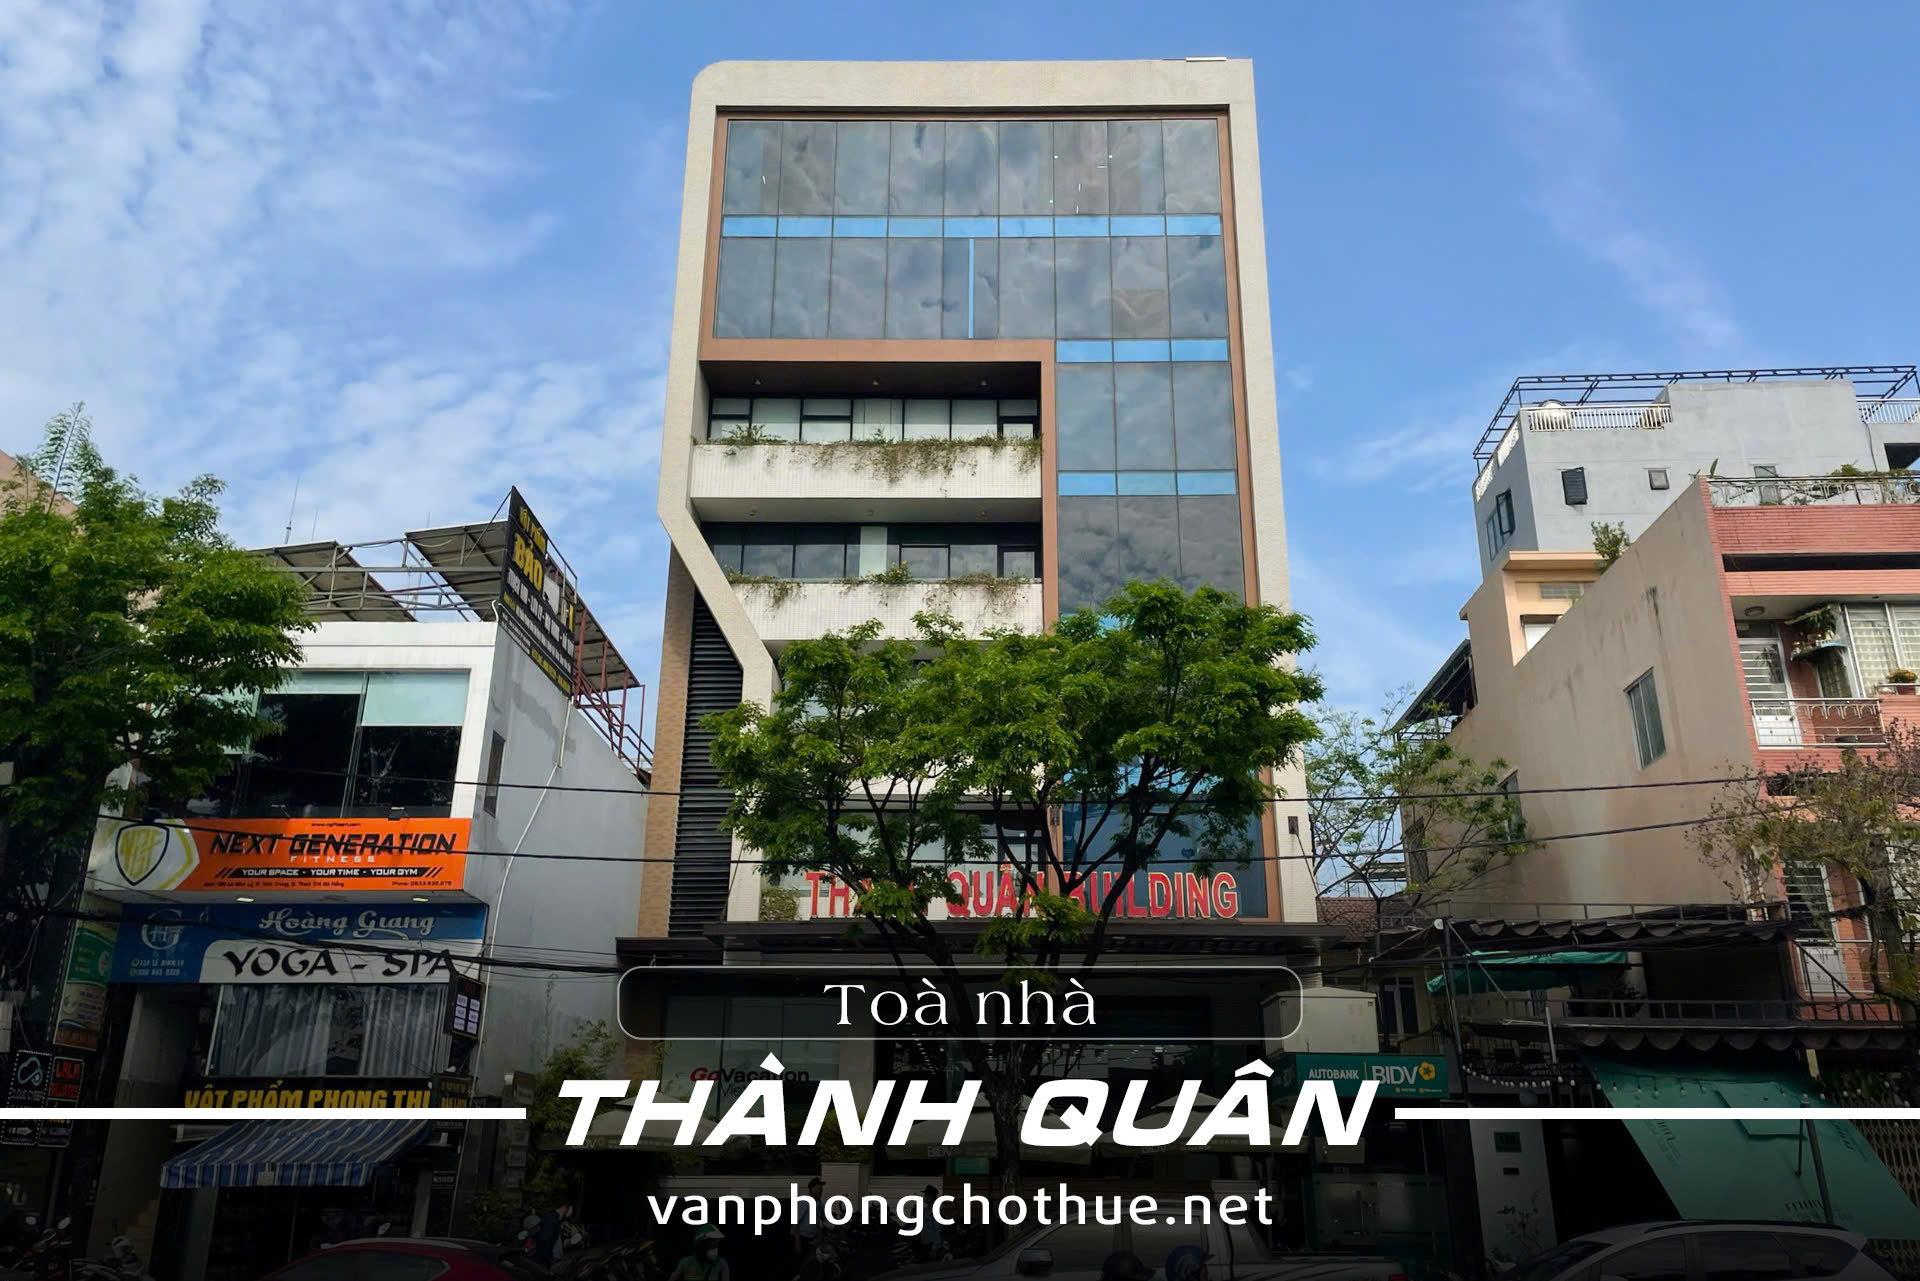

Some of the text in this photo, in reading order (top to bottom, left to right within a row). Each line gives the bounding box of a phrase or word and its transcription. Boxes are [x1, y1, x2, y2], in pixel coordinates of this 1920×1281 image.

[210, 833, 456, 855] NEXT GENERATION
[290, 855, 376, 863] FITNESS
[258, 907, 348, 936] Hoàng
[223, 948, 338, 977] YOGA
[382, 950, 455, 977] SPA
[1309, 1068, 1359, 1080] AUTOBANK
[1372, 1066, 1418, 1085] BIDV
[231, 1080, 304, 1108] PHẨM
[307, 1089, 389, 1108] PHONG
